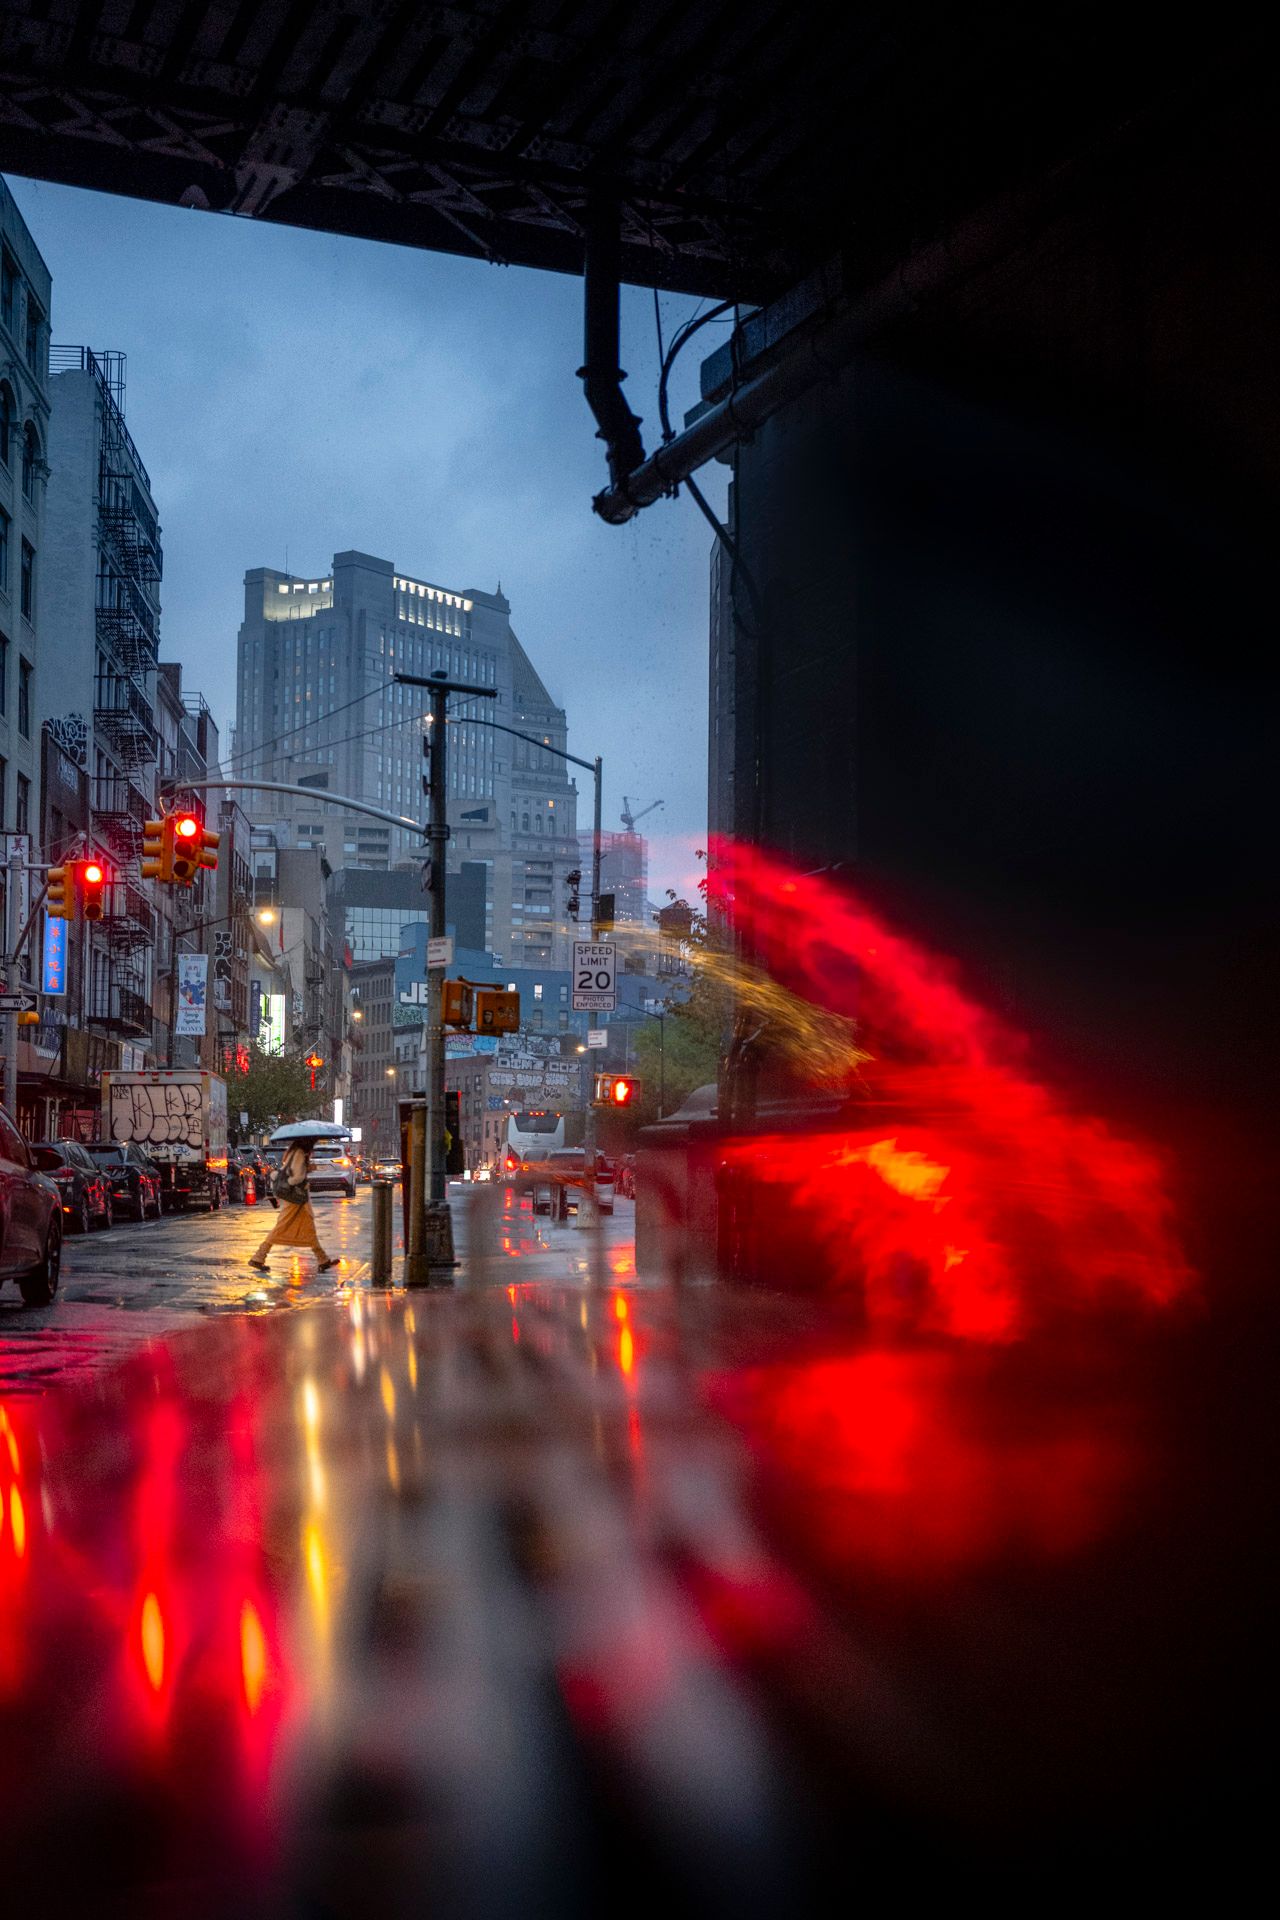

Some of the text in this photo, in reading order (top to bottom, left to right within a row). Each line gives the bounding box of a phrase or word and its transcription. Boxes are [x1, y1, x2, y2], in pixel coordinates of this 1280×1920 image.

[577, 946, 613, 955] SPEED
[580, 957, 608, 966] LIMIT
[578, 971, 611, 990] 20
[13, 999, 28, 1007] WAY
